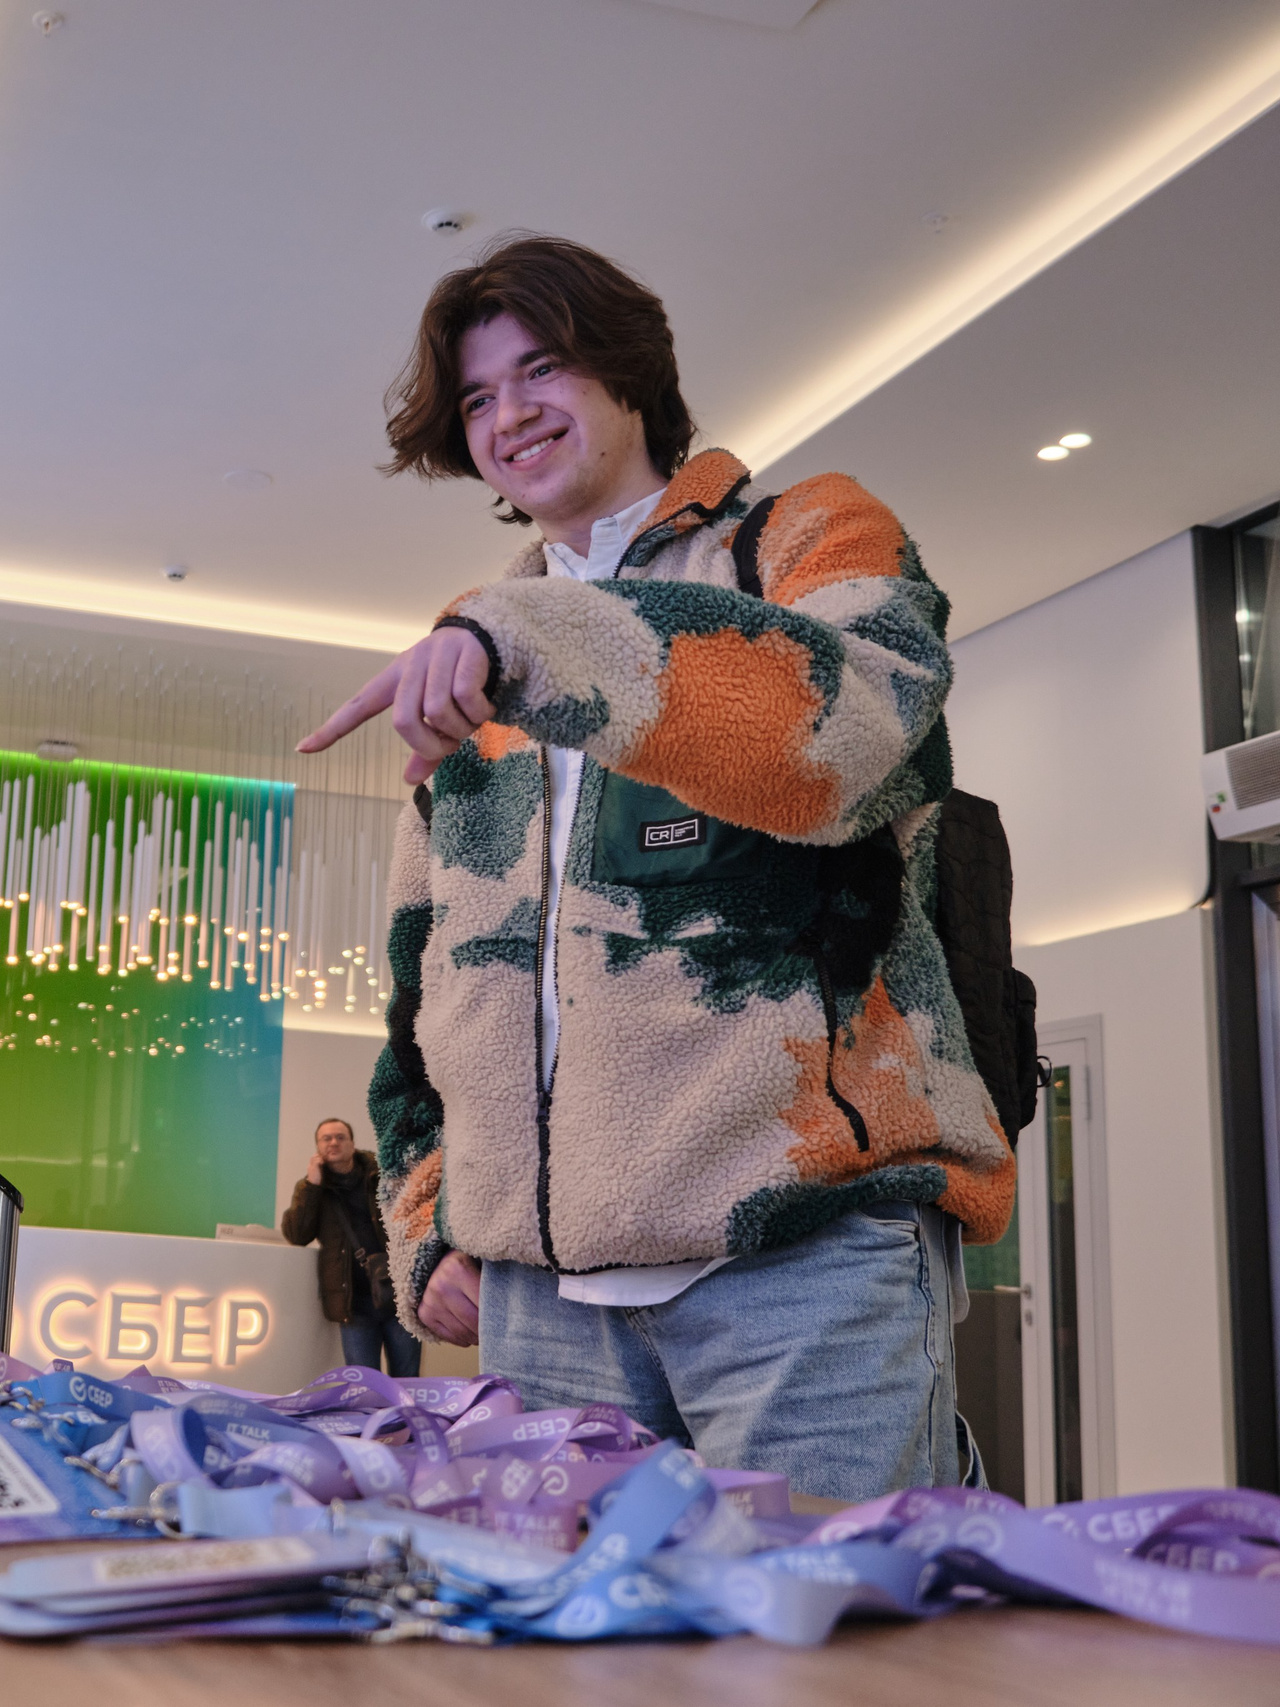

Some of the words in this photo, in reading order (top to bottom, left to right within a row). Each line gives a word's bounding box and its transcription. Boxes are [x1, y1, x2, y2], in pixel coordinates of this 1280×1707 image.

[650, 830, 670, 841] CR
[40, 1291, 269, 1366] СБЕР
[406, 1388, 440, 1403] СБЕ
[512, 1417, 570, 1441] СБЕР
